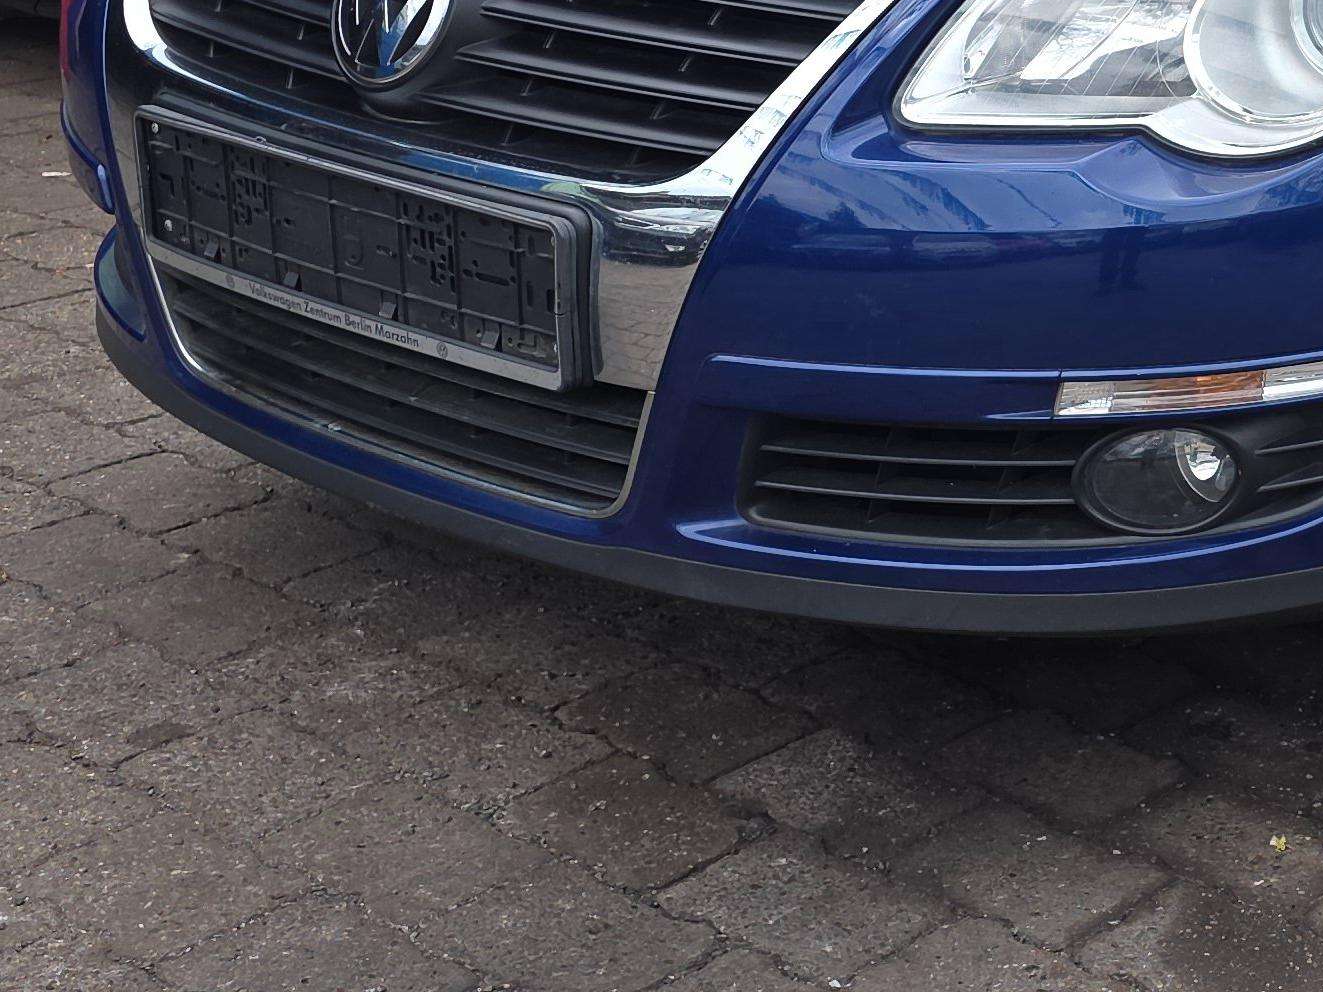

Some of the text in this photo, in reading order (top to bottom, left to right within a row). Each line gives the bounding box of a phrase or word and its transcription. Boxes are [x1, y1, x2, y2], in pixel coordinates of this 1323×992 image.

[248, 280, 302, 310] Volkswagen
[303, 300, 342, 325] Zentrum
[344, 313, 372, 333] Berlin
